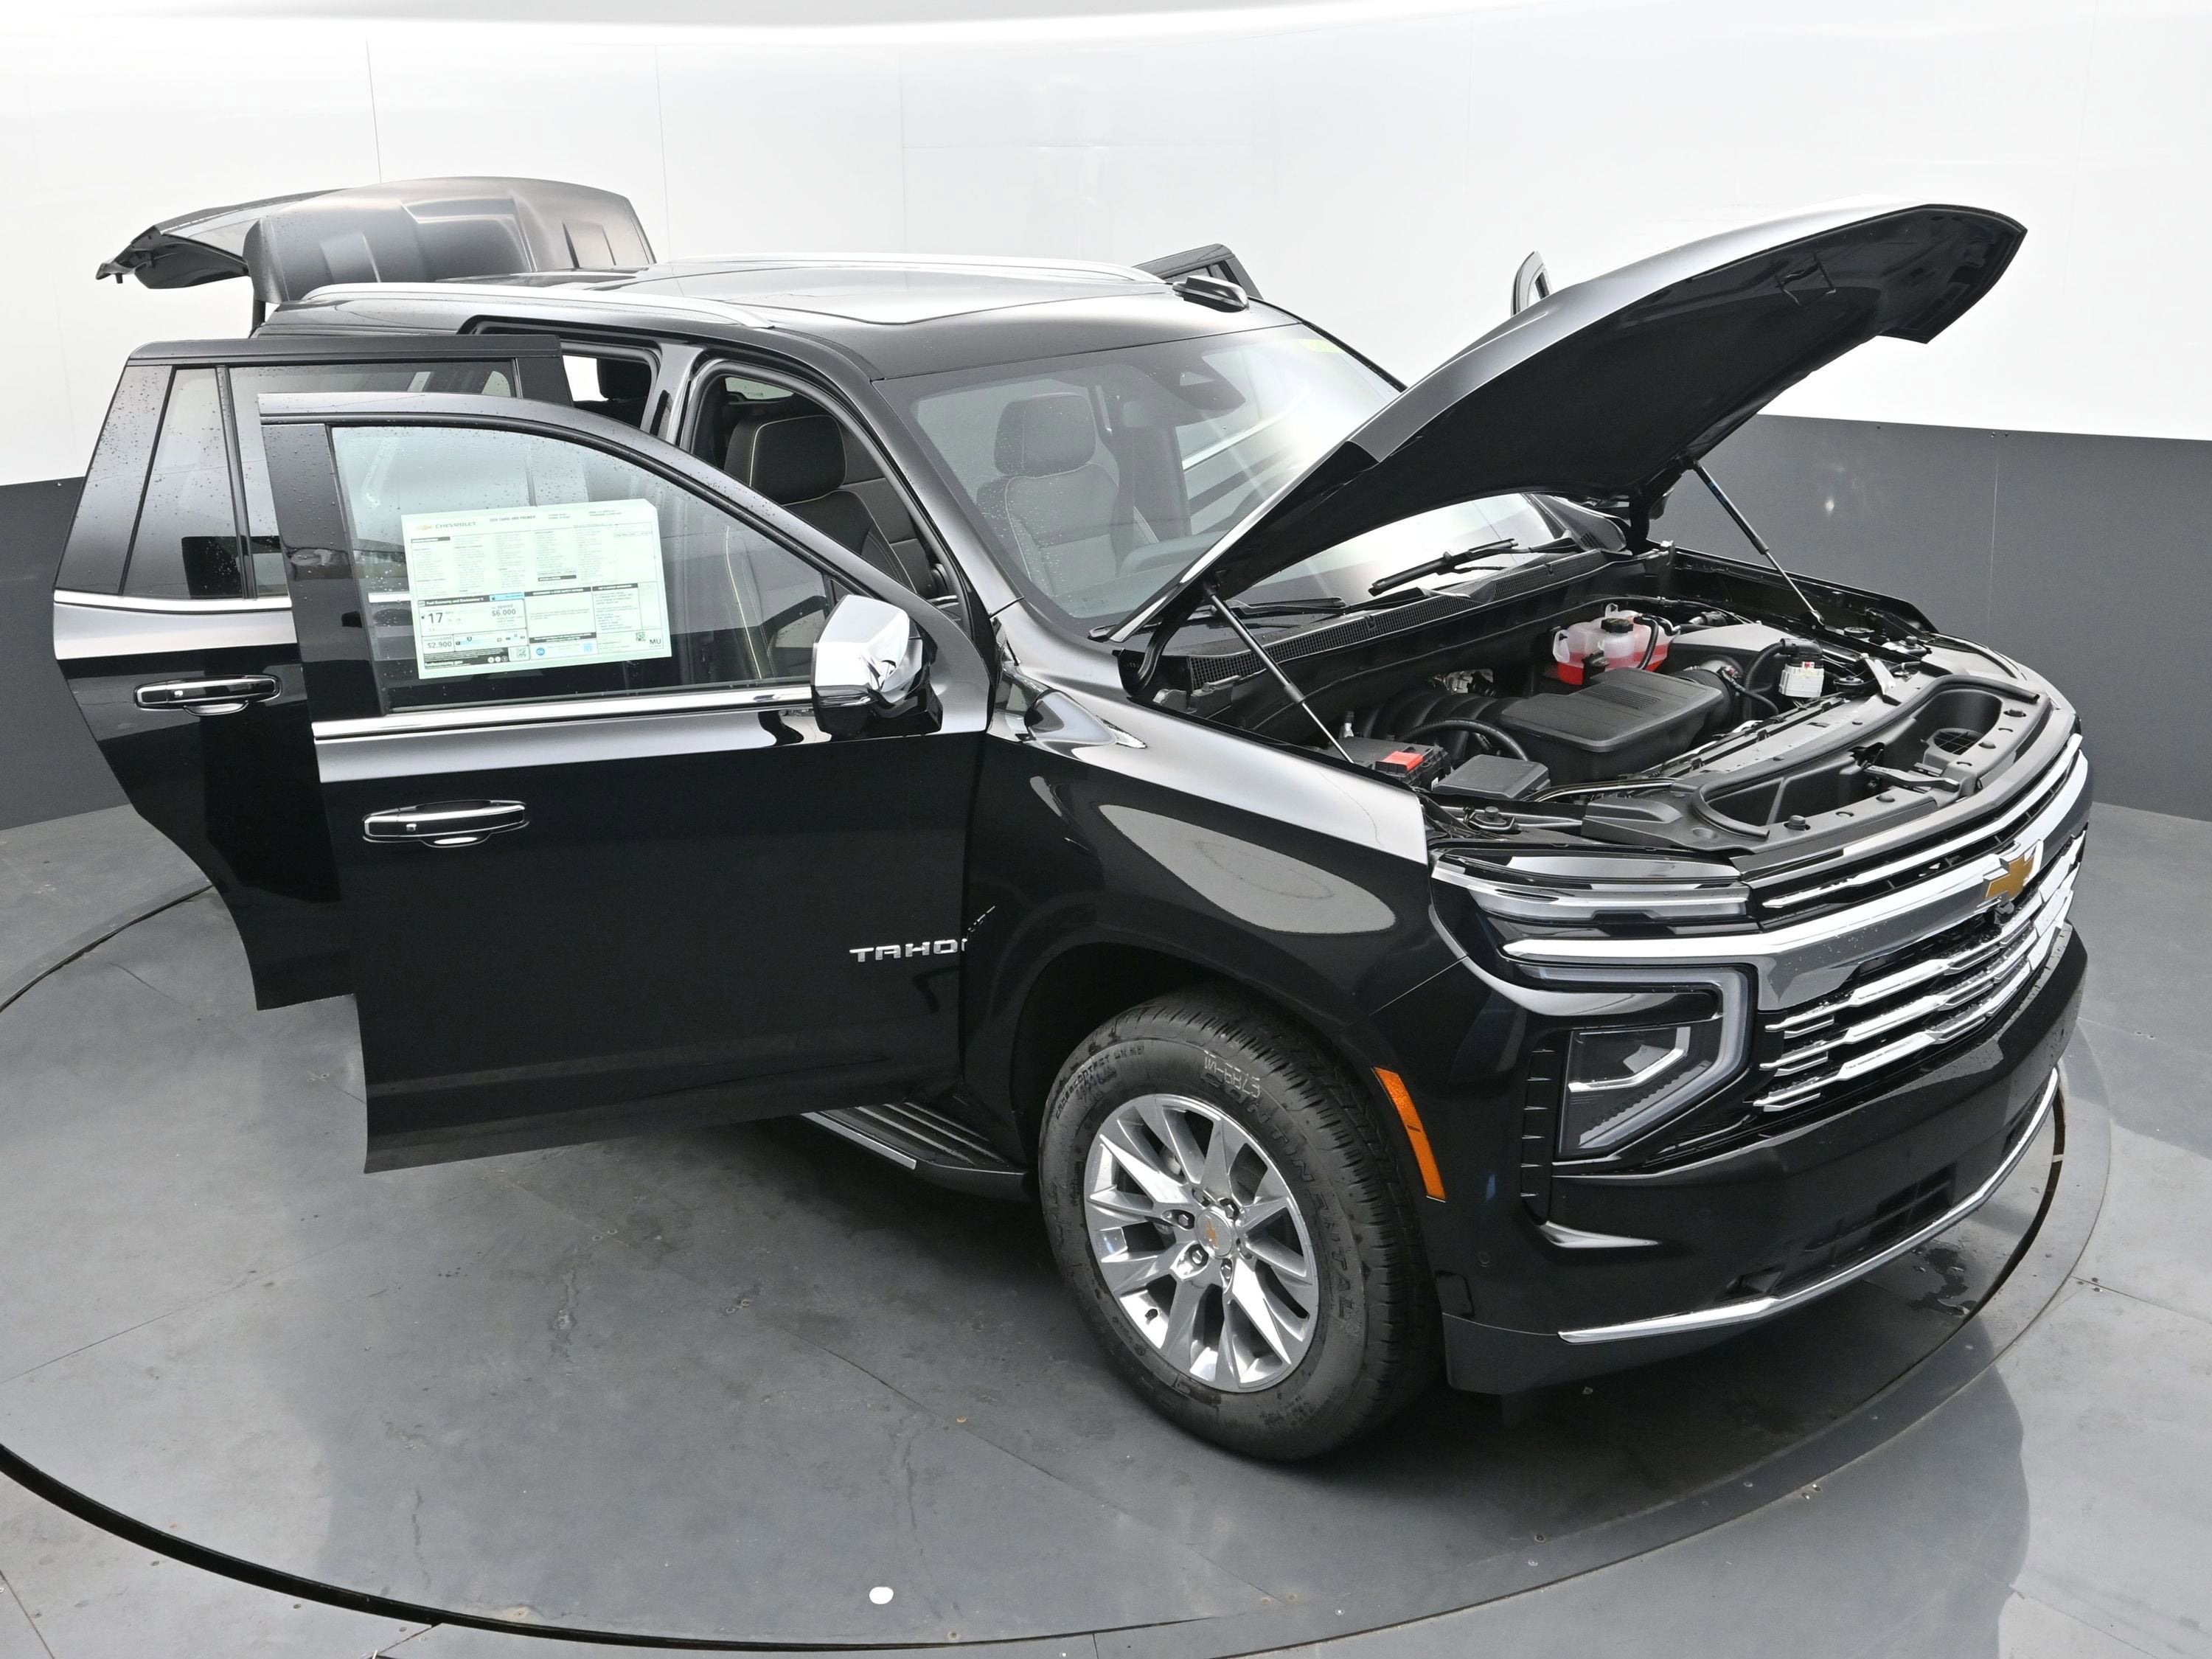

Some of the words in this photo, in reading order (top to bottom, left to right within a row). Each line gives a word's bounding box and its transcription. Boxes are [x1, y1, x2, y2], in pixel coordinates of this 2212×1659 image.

[492, 608, 516, 616] $6,000
[428, 612, 443, 624] 17
[427, 641, 452, 649] $2,900
